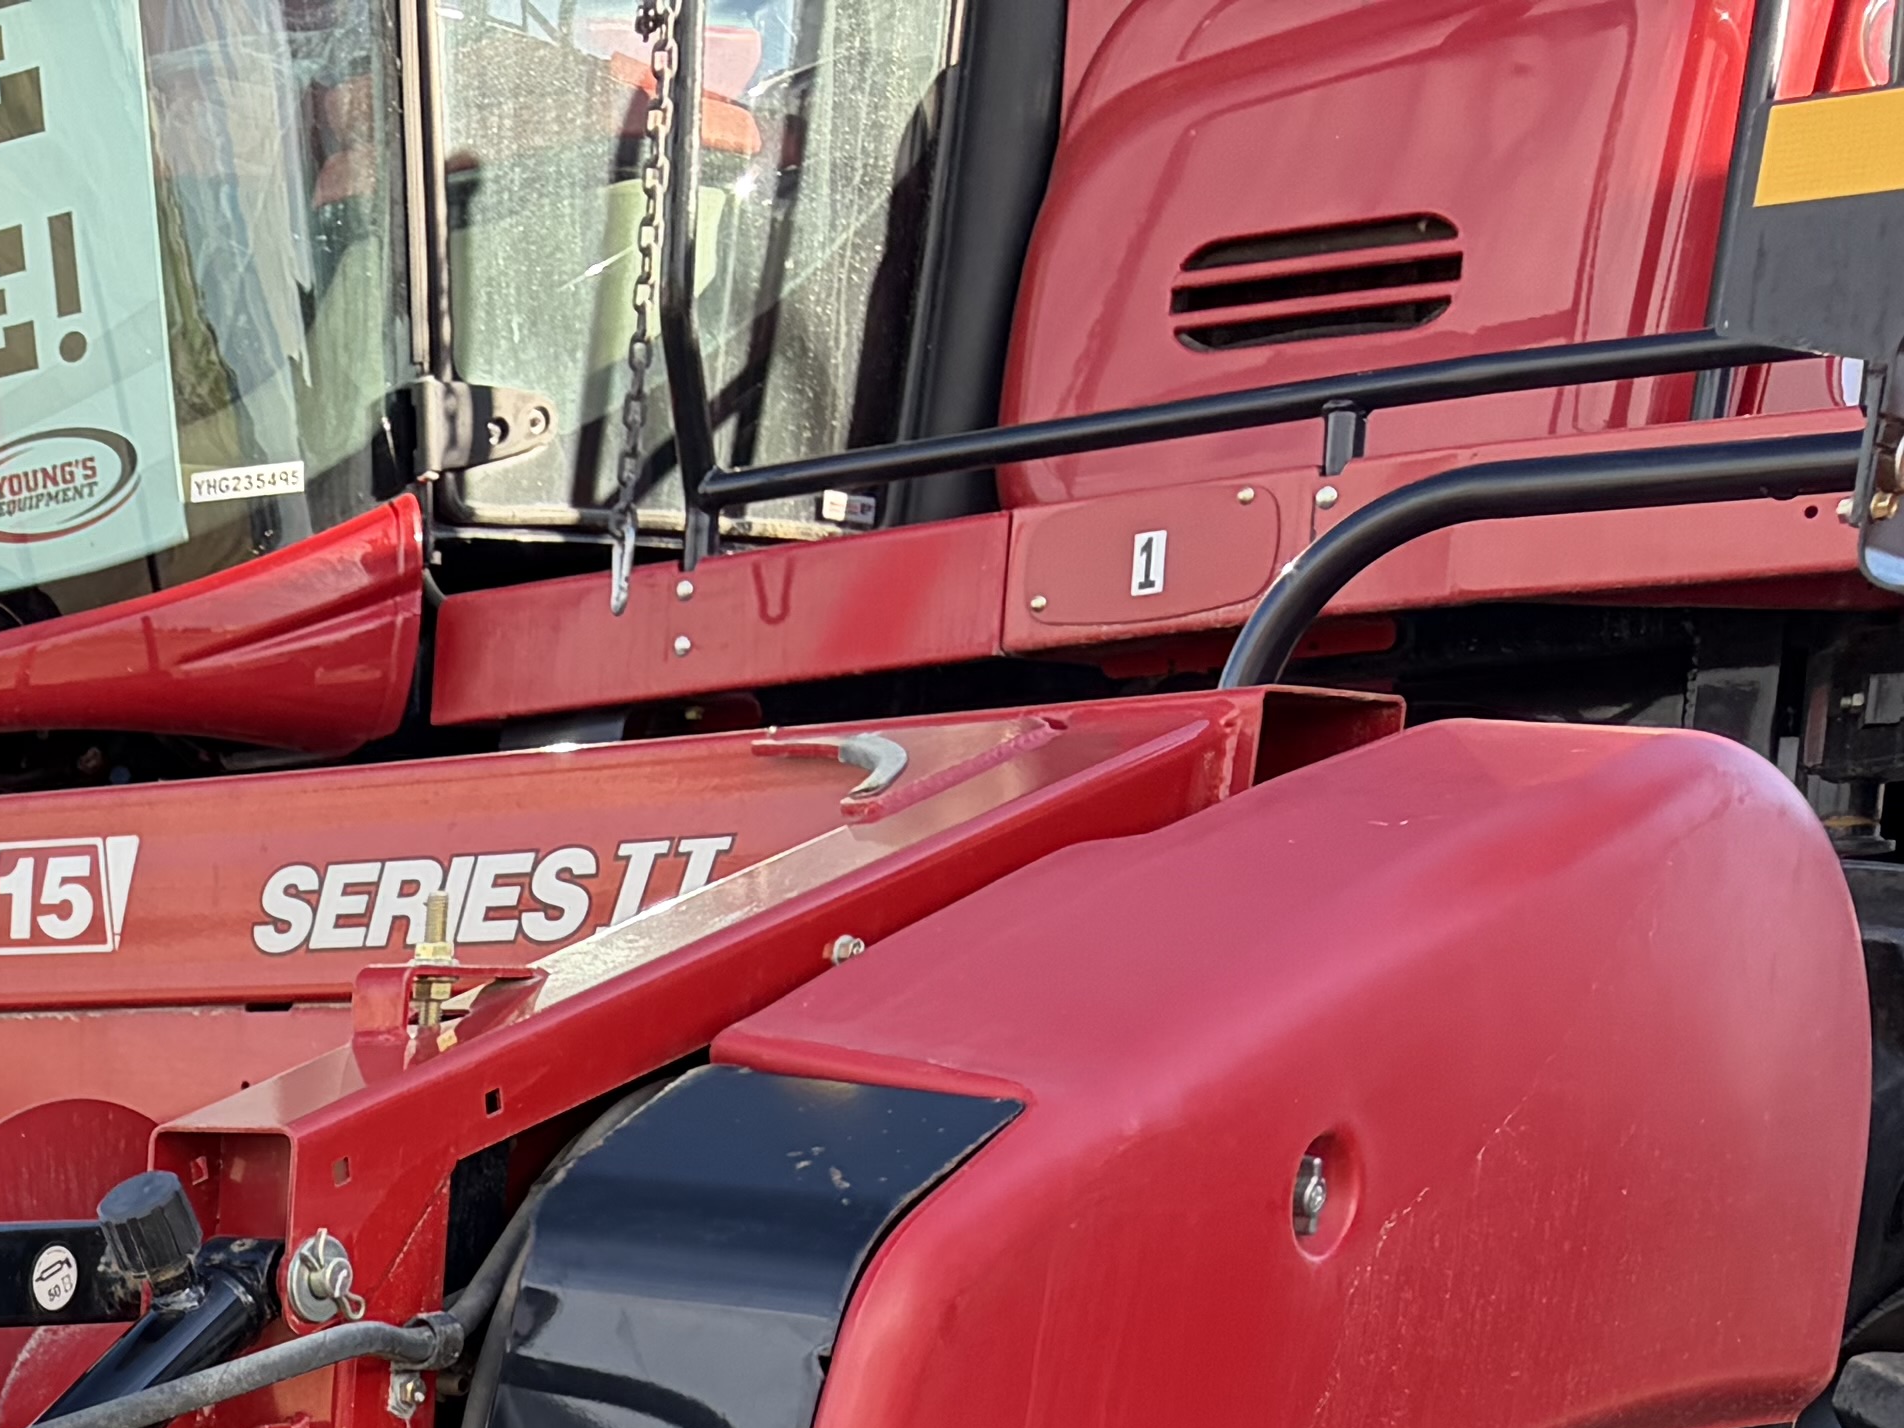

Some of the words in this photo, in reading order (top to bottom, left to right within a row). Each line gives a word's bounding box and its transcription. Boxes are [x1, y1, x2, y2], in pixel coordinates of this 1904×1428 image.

[193, 470, 301, 498] YHG235495
[1137, 535, 1158, 591] 1
[251, 845, 598, 957] SERIES
